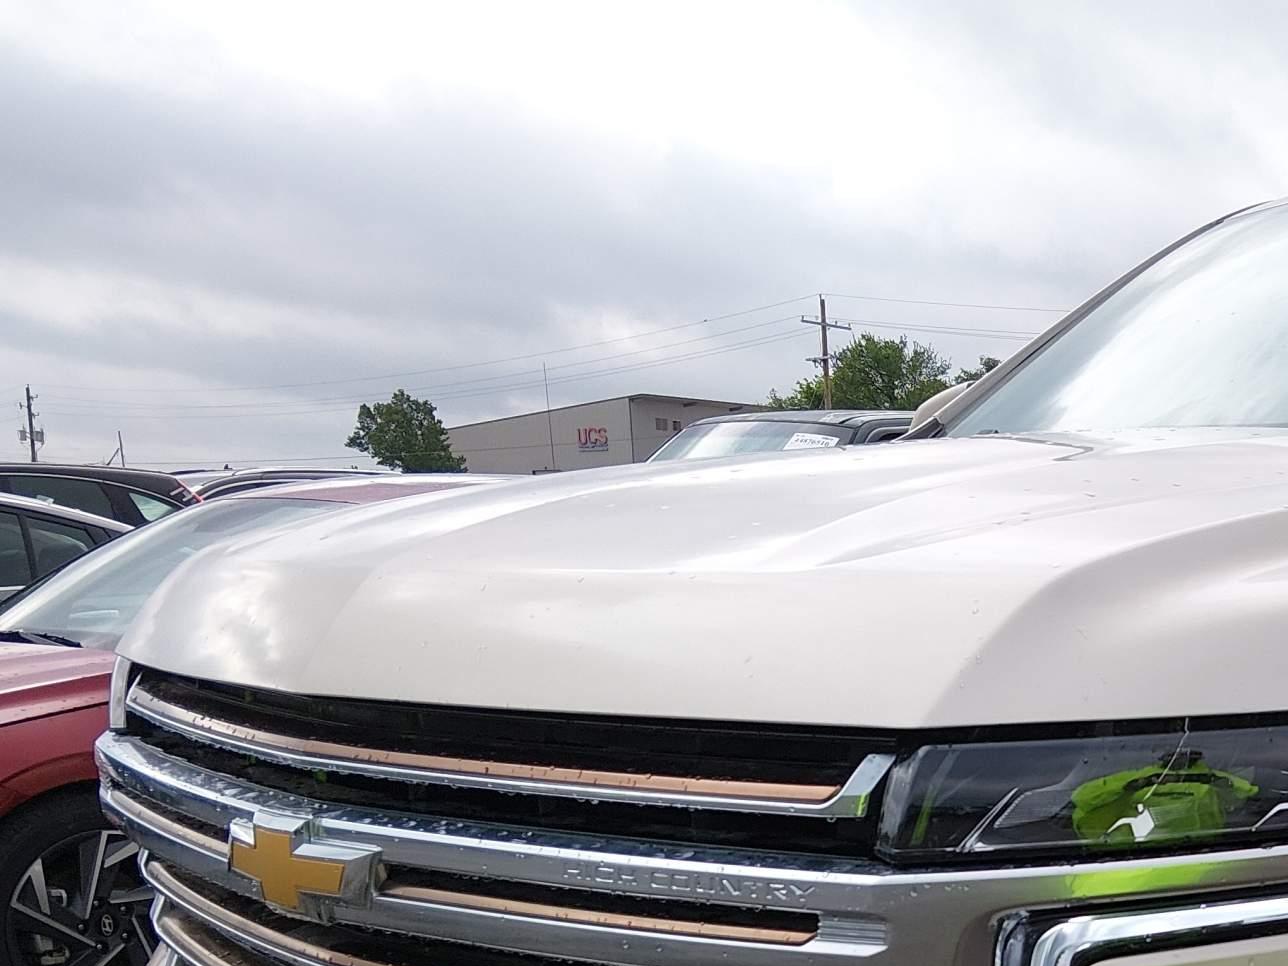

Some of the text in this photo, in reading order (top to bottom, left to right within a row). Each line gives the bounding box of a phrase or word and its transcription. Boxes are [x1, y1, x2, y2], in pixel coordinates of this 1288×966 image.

[577, 428, 608, 445] UCS
[563, 860, 816, 901] HIGH COUNTRY
